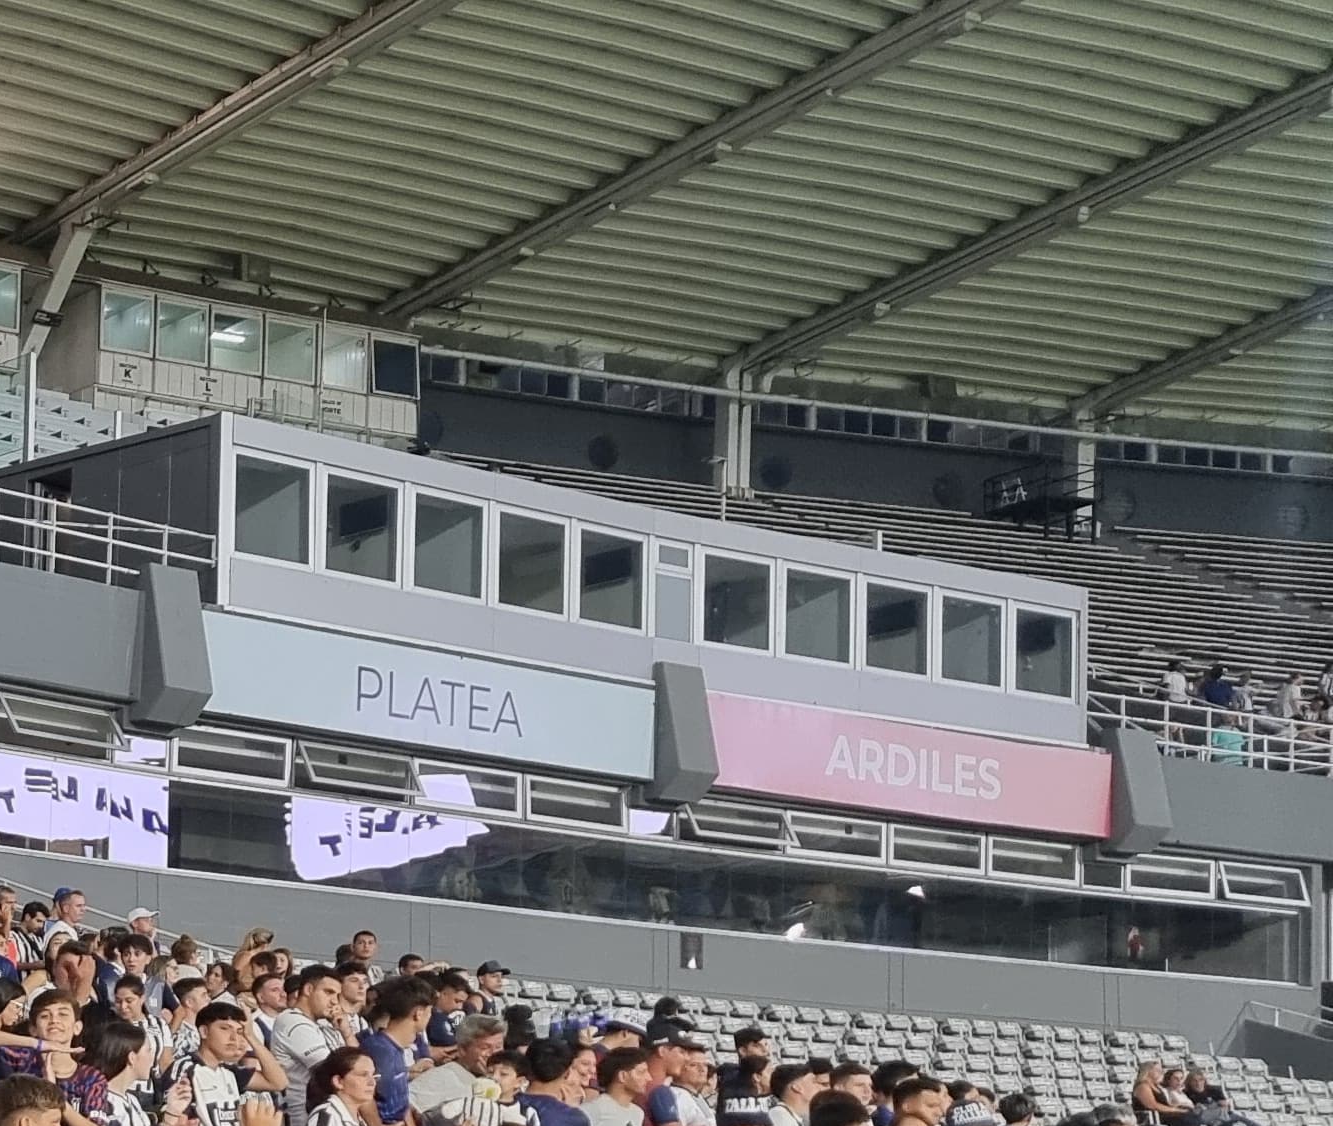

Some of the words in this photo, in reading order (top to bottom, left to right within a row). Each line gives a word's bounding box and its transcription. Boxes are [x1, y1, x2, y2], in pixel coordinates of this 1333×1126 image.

[125, 369, 132, 379] K
[206, 382, 211, 392] L
[355, 665, 524, 738] PLATEA
[825, 735, 1002, 801] ARDILES
